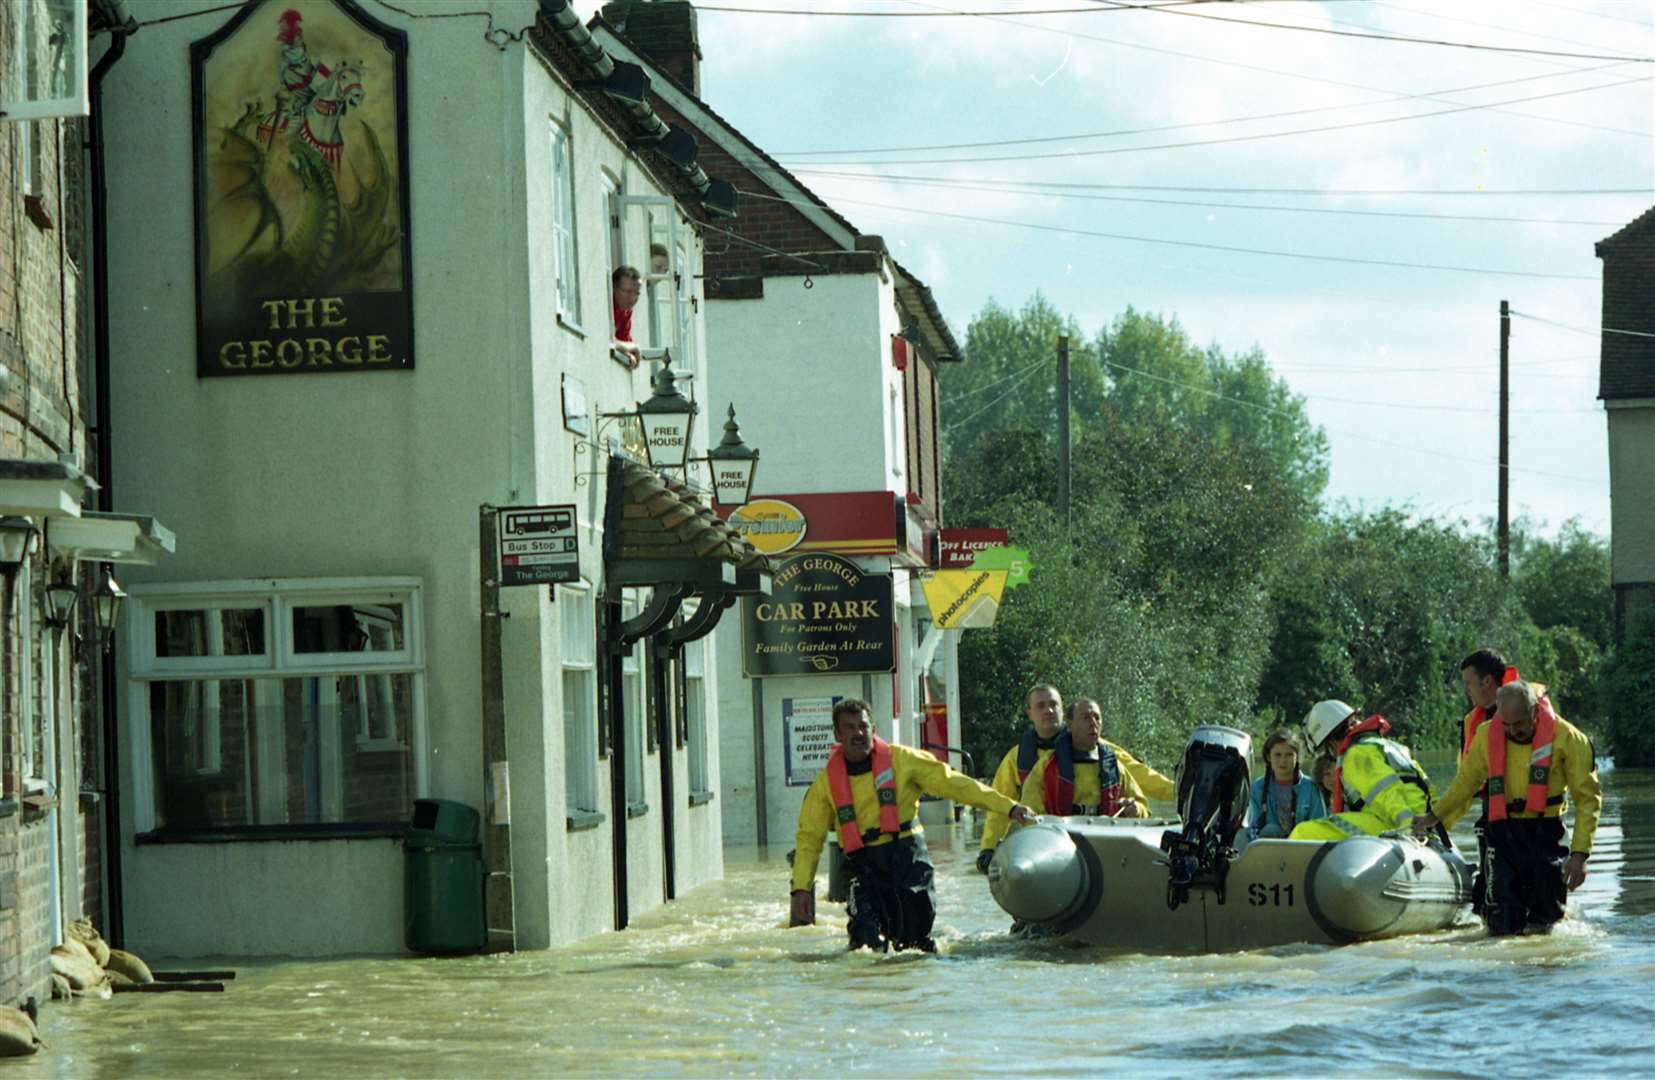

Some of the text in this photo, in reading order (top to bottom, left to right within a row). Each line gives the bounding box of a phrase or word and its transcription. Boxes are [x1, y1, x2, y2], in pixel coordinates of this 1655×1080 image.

[262, 297, 347, 330] THE
[219, 335, 392, 368] GEORGE
[653, 426, 679, 436] FREE
[649, 437, 684, 446] HOUSE
[721, 471, 743, 480] FREE
[716, 480, 747, 489] HOUSE
[508, 541, 556, 551] Bus Stop
[516, 570, 569, 579] The George
[774, 558, 860, 588] THE GEORGE
[1011, 562, 1024, 577] 5
[793, 583, 839, 592] Free House
[938, 571, 990, 626] photocopies
[756, 600, 880, 621] CAR PARK
[780, 622, 857, 633] For Patrons Only
[755, 640, 883, 654] Family Garden At Rear
[795, 724, 834, 732] MAIDSTON
[796, 743, 832, 752] CELEBRAT
[802, 752, 819, 760] NEW
[1248, 882, 1294, 906] S11
